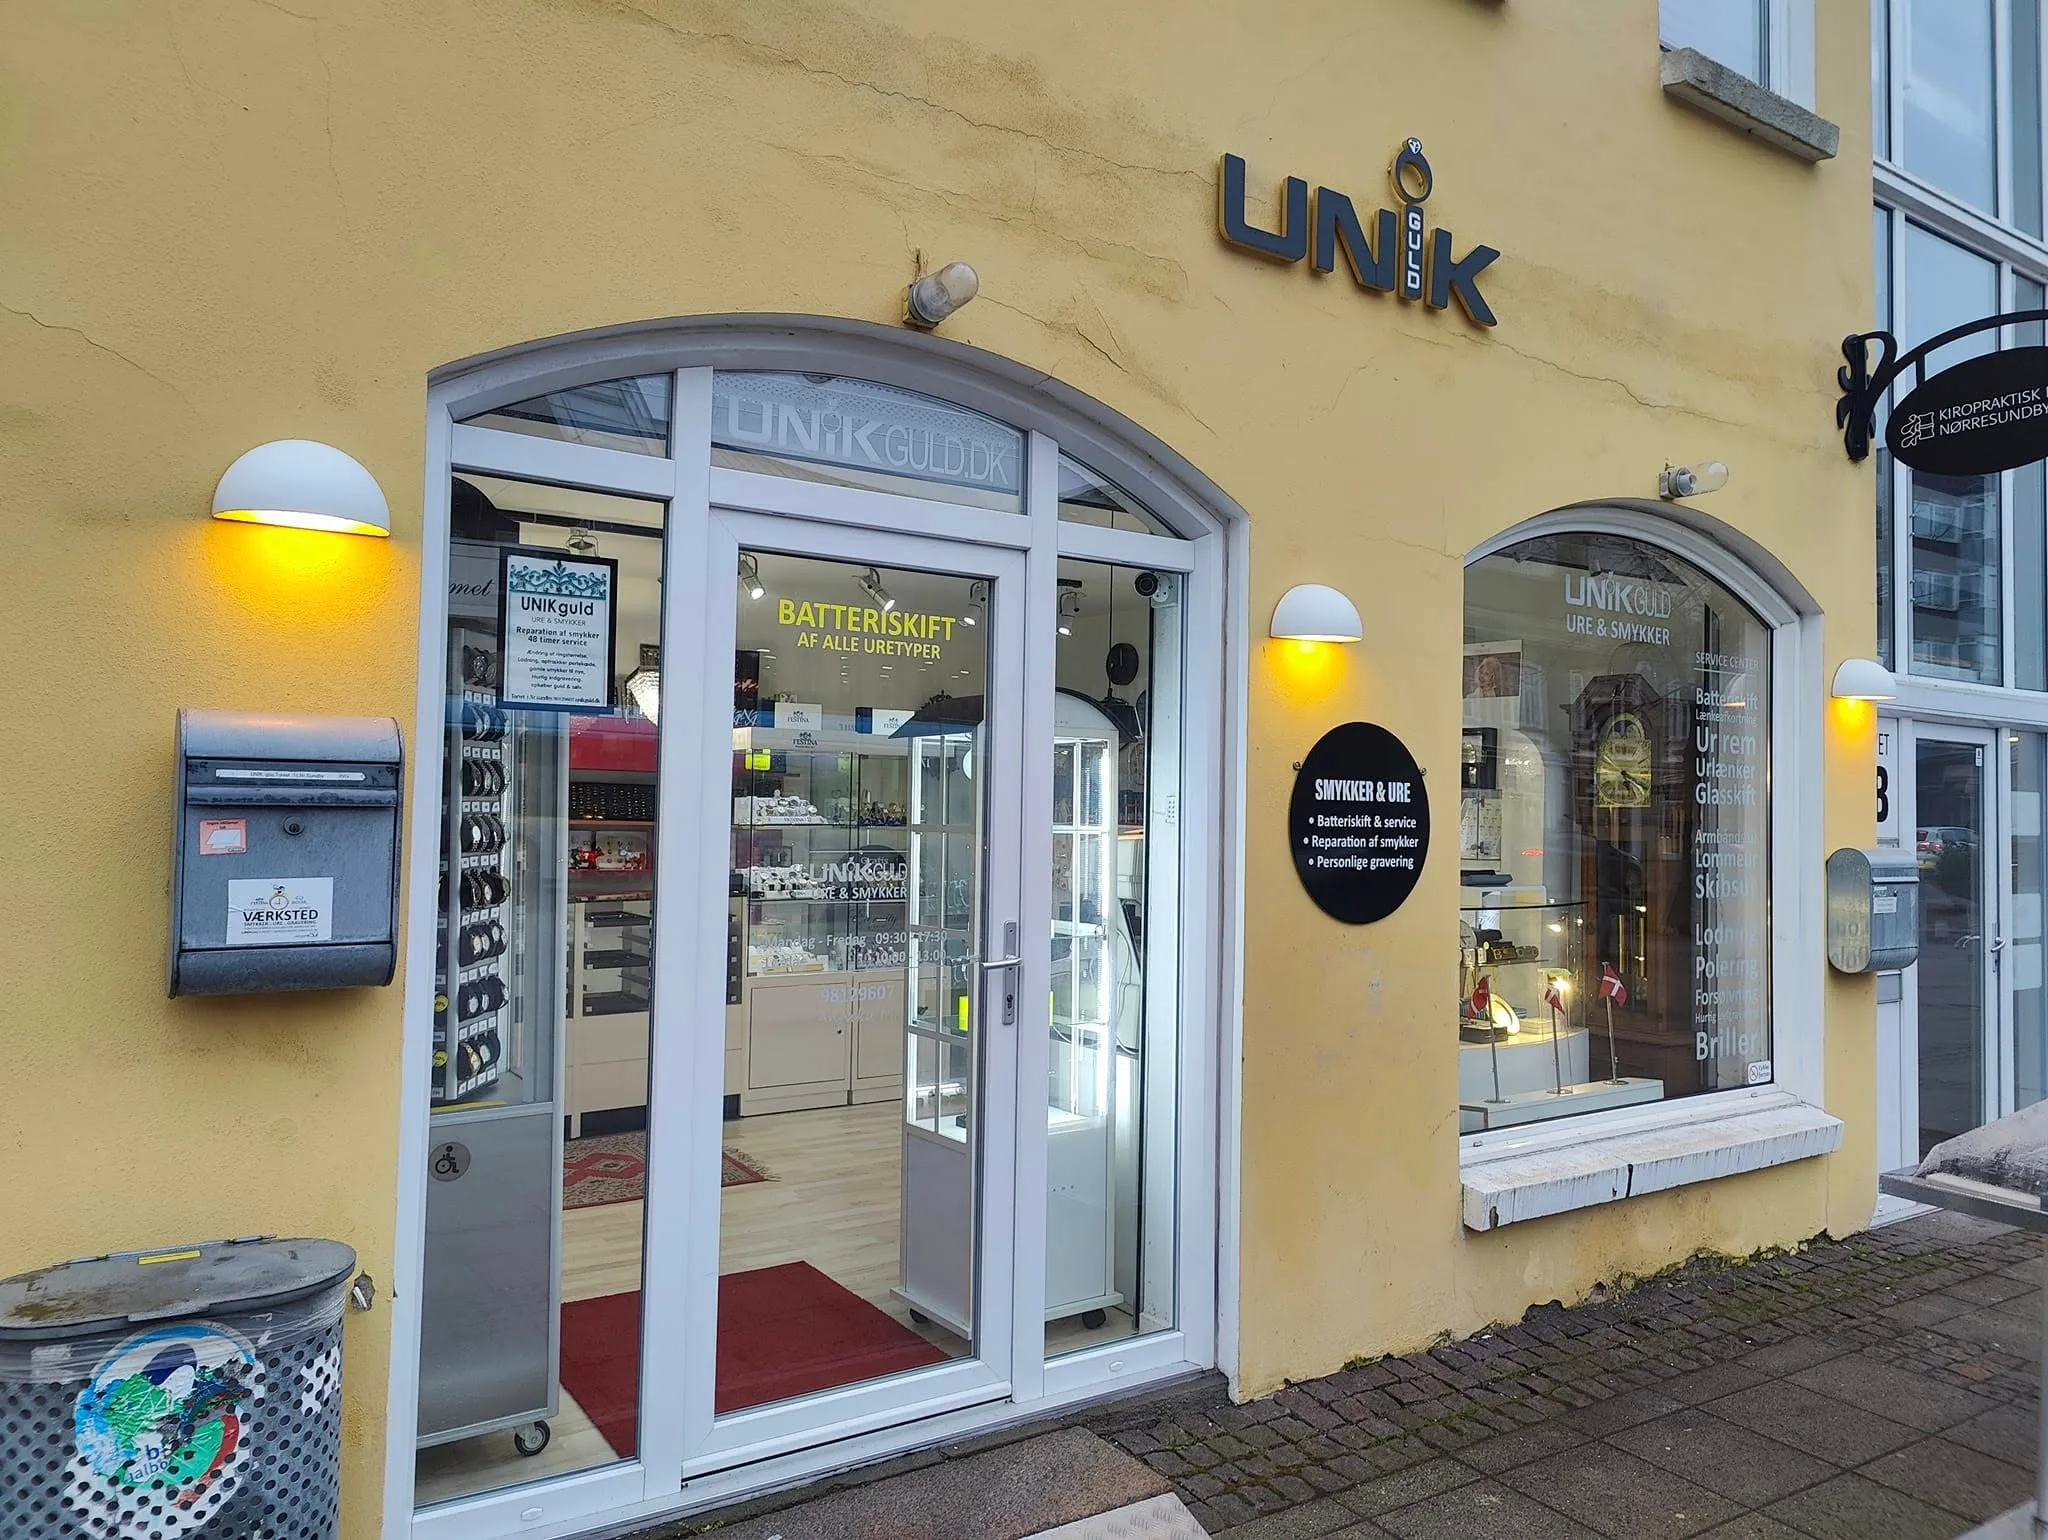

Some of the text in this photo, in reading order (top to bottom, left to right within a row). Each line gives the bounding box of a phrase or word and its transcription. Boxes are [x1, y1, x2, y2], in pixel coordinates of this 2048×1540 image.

[1407, 211, 1421, 290] GULD
[1939, 387, 2041, 421] KIROPRAKTISK
[1939, 402, 2048, 436] NØRRESUNDBY
[531, 616, 544, 624] URE
[553, 617, 586, 627] SMYKKER
[778, 598, 956, 641] BATTERISKIFT
[1566, 613, 1671, 646] URE & SMYKKER
[516, 626, 600, 640] Reparation af smykker
[527, 635, 588, 647] 48 timer service
[797, 631, 941, 660] AF ALLE URETYPER
[1695, 651, 1759, 670] SERVICE CENTER
[792, 738, 819, 747] FESTINA
[1696, 725, 1757, 756] Ur rem
[1695, 756, 1757, 780] Urlænker
[1314, 778, 1411, 804] SMYKKER & URE
[1695, 781, 1757, 807] Glasskift
[1317, 814, 1417, 829] Batteriskift & service
[1311, 835, 1419, 850] Reparation af smykker
[1316, 855, 1415, 870] Personlige gravering
[1695, 847, 1758, 869] Lommeur
[839, 887, 849, 899] &
[852, 886, 908, 900] SMYKKER
[1695, 873, 1755, 899] Skibsur
[242, 909, 319, 922] VÆRKSTED
[766, 935, 816, 950] Mandag
[826, 933, 867, 948] Fredag
[875, 931, 907, 944] 09:30
[1695, 954, 1758, 980] Polering
[1695, 1011, 1717, 1025] Hurtig
[1696, 1026, 1758, 1061] Briller
